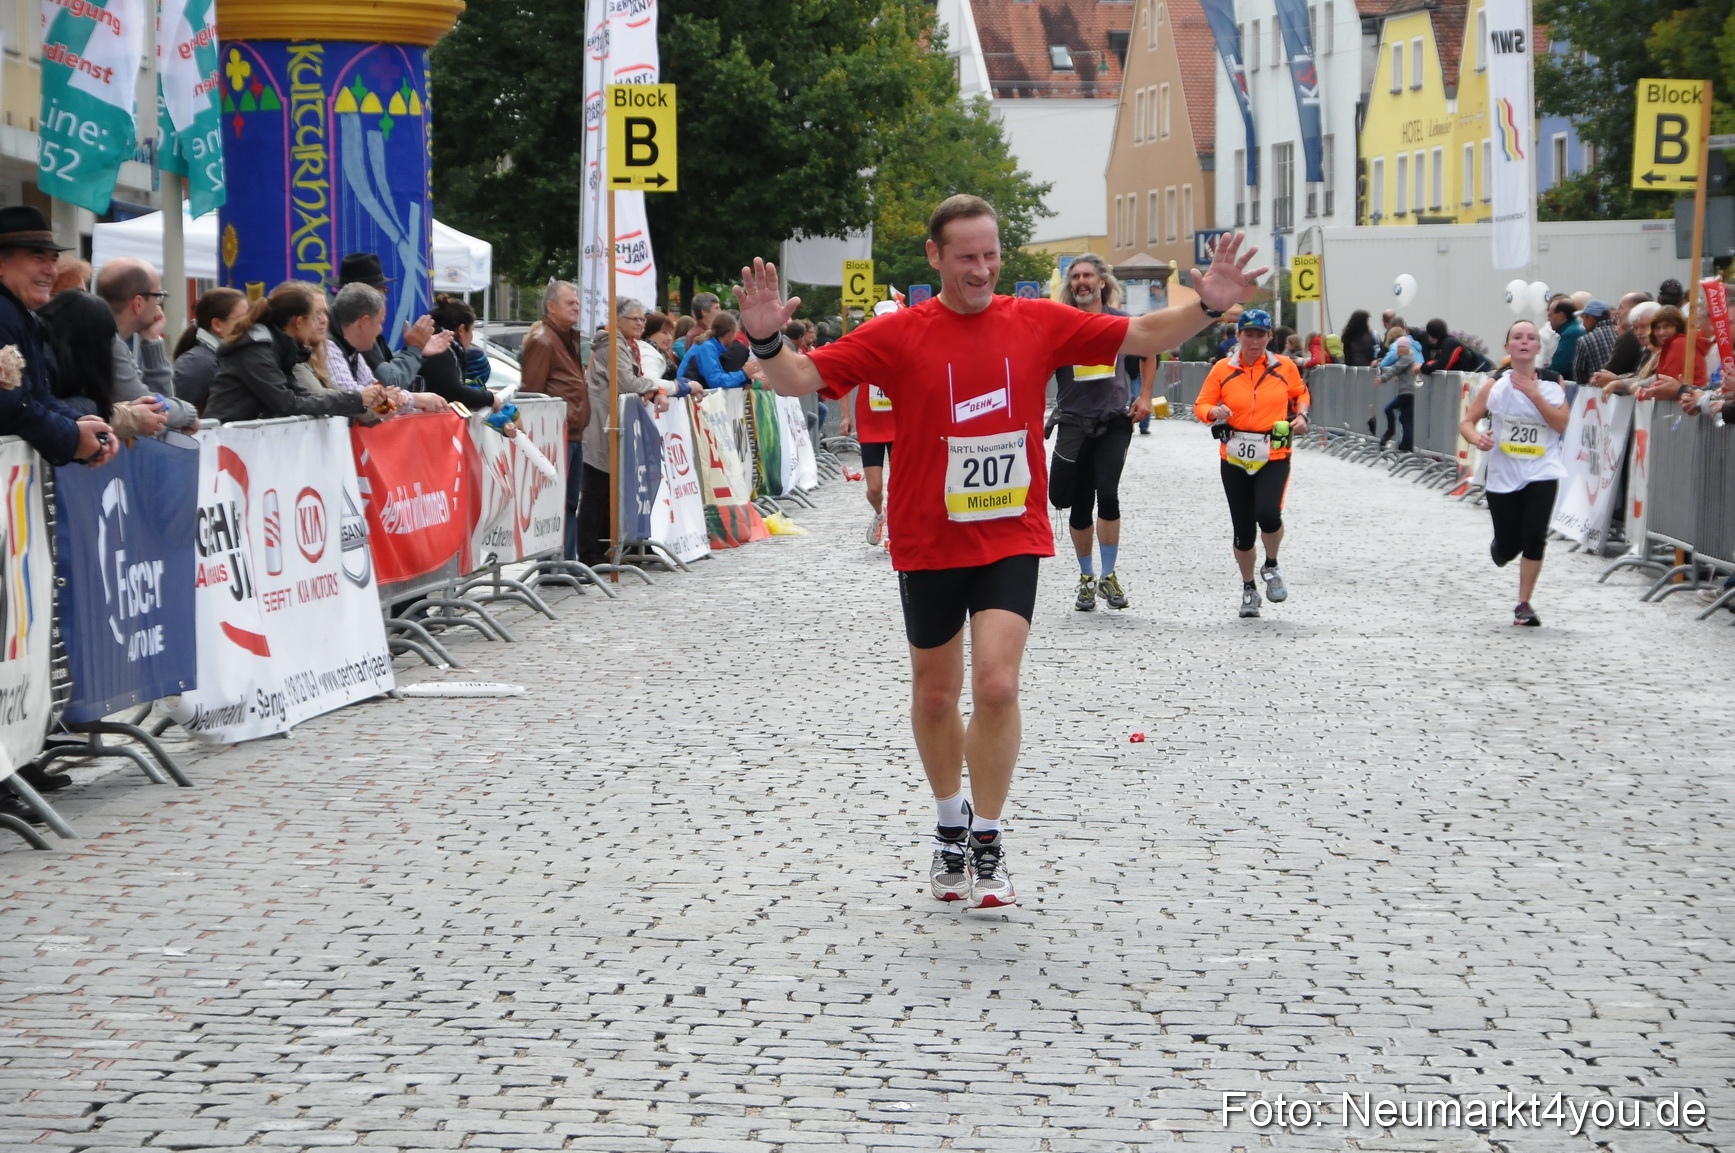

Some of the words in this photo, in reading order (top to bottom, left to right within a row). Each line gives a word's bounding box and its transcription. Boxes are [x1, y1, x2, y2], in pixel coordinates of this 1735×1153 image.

[614, 88, 668, 107] Block
[1647, 84, 1704, 104] Block
[624, 116, 659, 167] B
[1654, 112, 1690, 165] B
[846, 261, 870, 270] Block
[1294, 257, 1319, 266] Block
[850, 273, 866, 295] C
[1298, 269, 1315, 291] C
[1708, 288, 1723, 318] Audi
[1715, 320, 1730, 346] BKK
[970, 397, 993, 413] DEHN
[1510, 426, 1538, 443] 230
[977, 441, 1016, 453] Neumarkt
[1238, 442, 1256, 459] 36
[963, 453, 1015, 488] 207
[968, 493, 1012, 509] Michael
[298, 505, 324, 546] KIA
